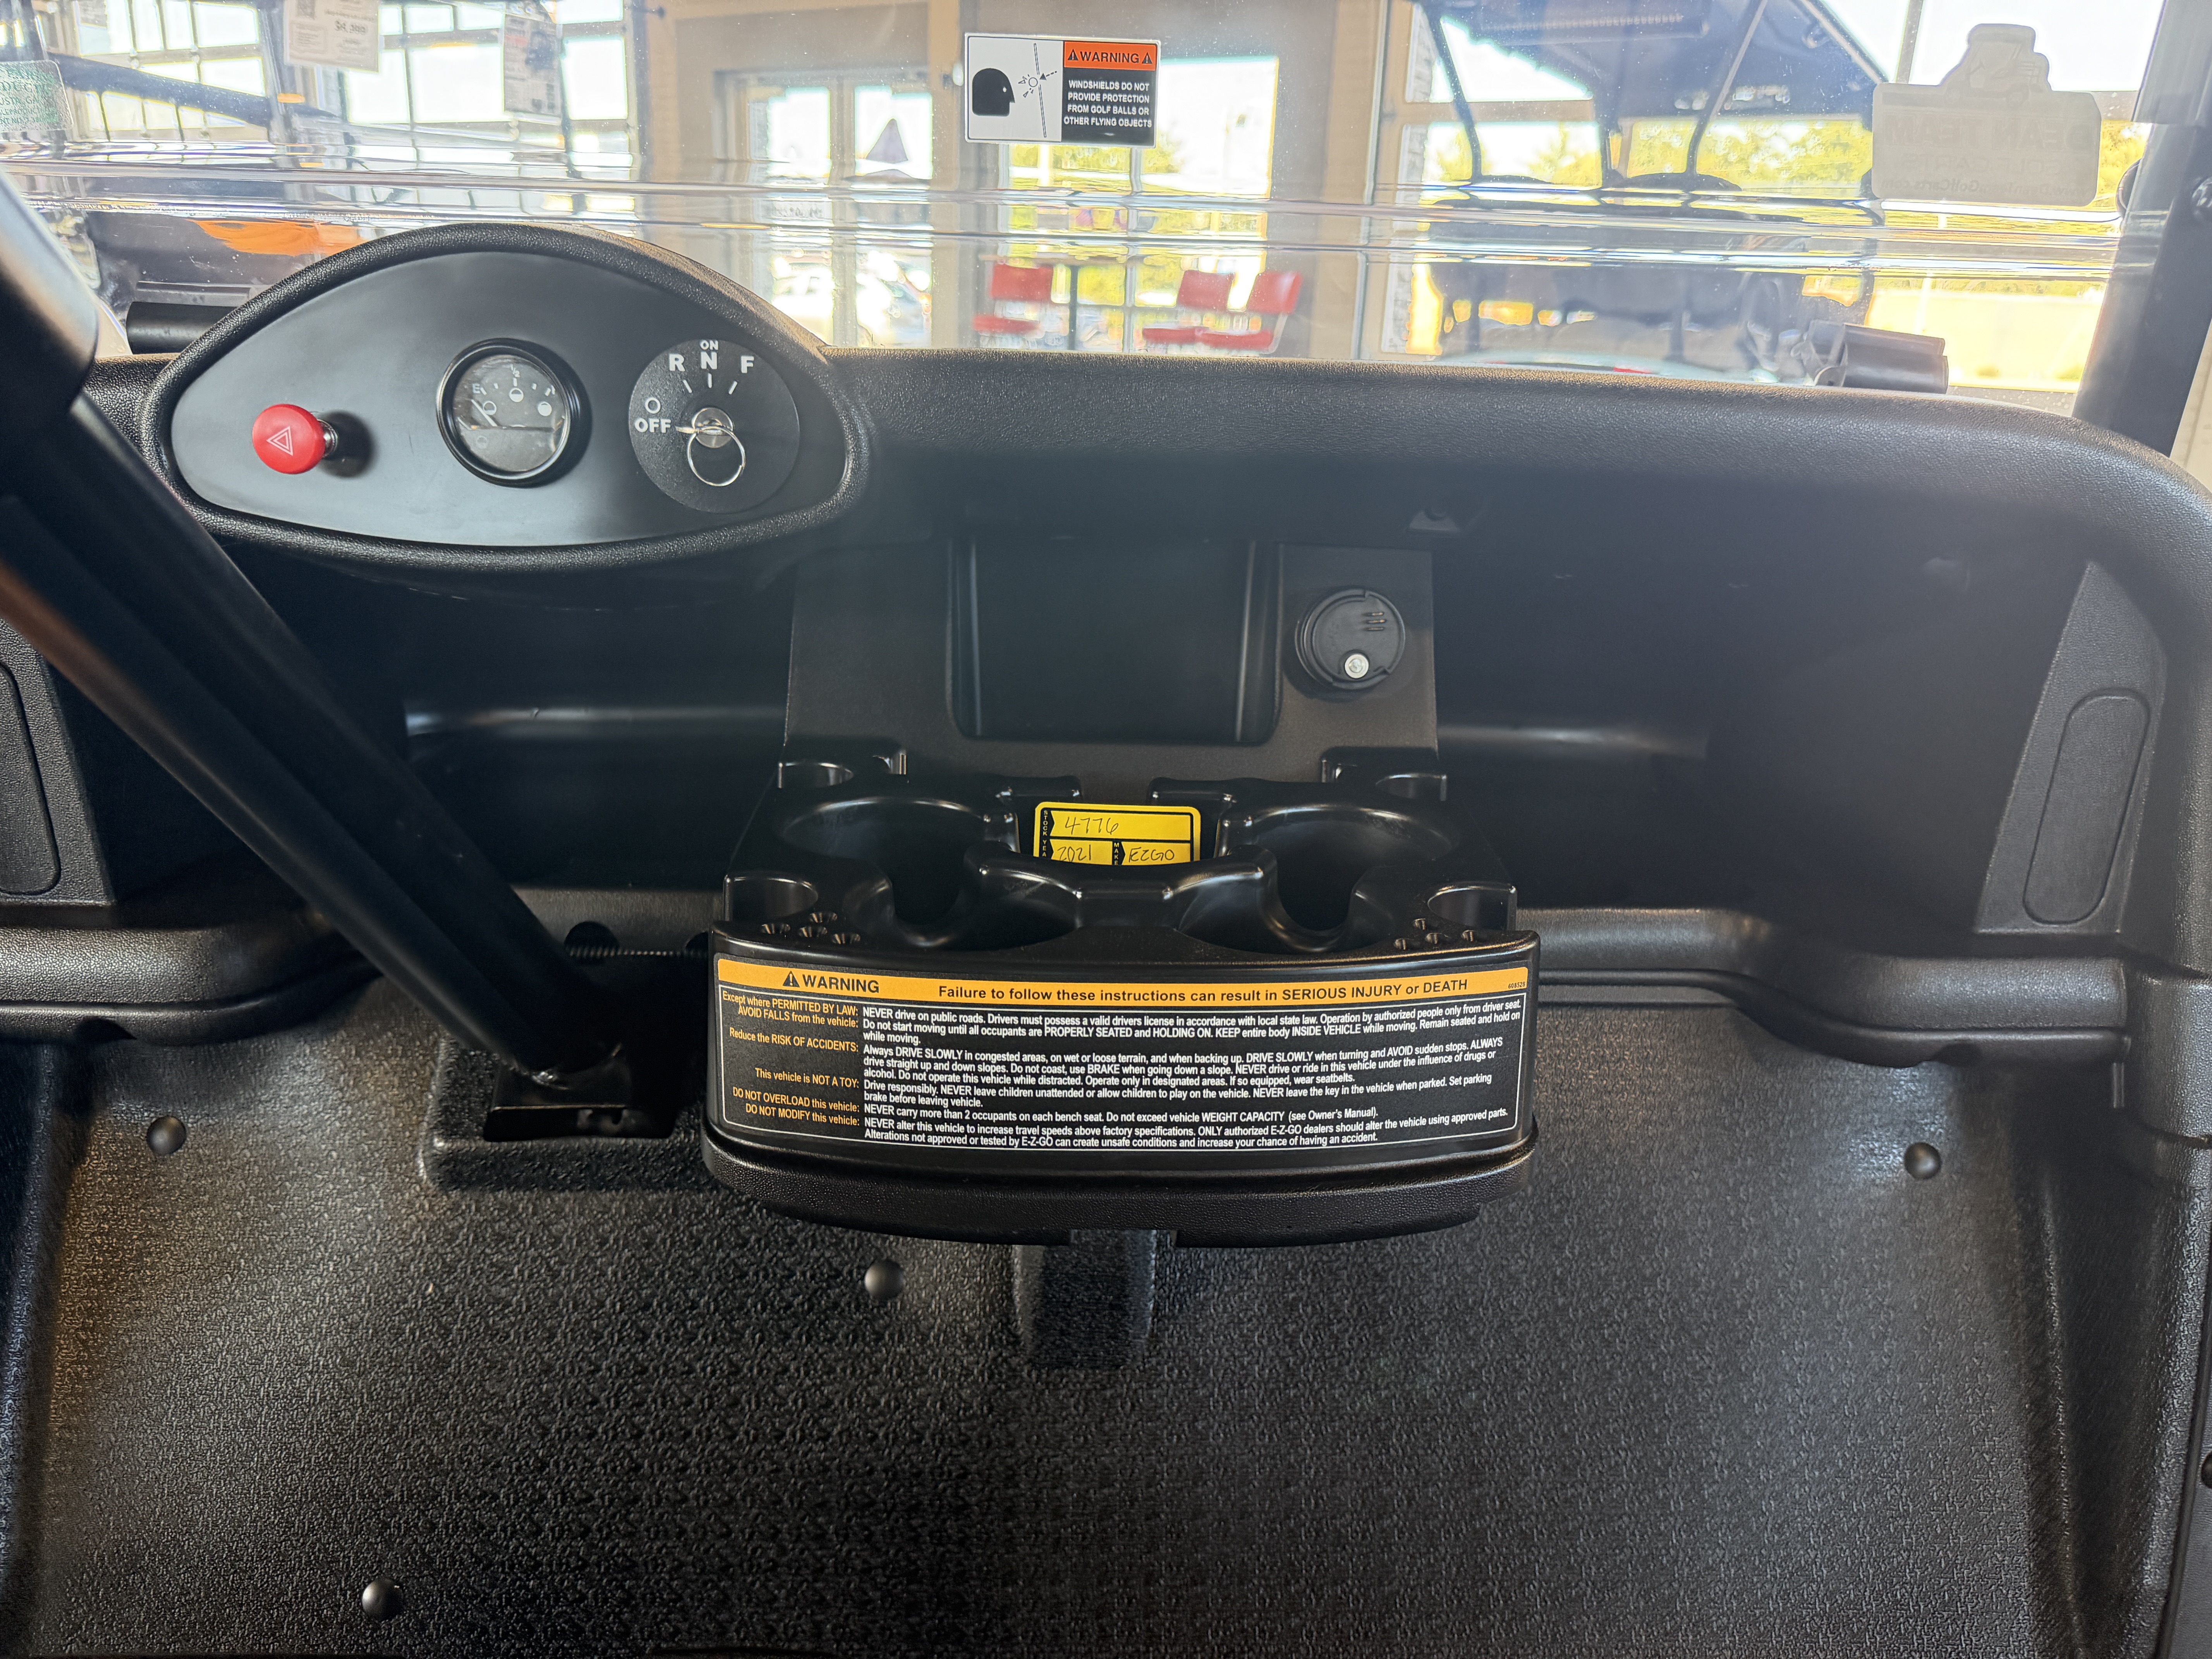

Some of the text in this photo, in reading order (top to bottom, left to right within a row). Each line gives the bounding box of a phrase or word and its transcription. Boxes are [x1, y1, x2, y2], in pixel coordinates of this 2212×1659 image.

[1080, 51, 1139, 64] WARNING
[1068, 80, 1149, 91] WINDSHIELDS DO NOT
[1068, 92, 1149, 103] PROVIDE PROTECTION
[1067, 104, 1149, 116] FROM GOLF BALLS OR
[1064, 117, 1152, 128] OTHER FLYING OBJECTS
[700, 340, 718, 350] ON
[669, 352, 754, 373] R N F
[472, 383, 481, 394] E
[635, 418, 671, 433] OFF
[1065, 816, 1119, 835] 4776
[1057, 844, 1092, 862] 2021
[802, 974, 879, 993] WARNING
[939, 979, 1468, 1001] Failure to follow these instructions can result in SERIOUS INJURY or DEATH
[1508, 981, 1526, 989] 608528
[723, 991, 858, 1016] Except where PERMITTED BY LAW:
[863, 1008, 893, 1019] NEVER
[895, 1009, 916, 1020] drive
[931, 1011, 957, 1024] public
[959, 1012, 986, 1023] roads.
[988, 1013, 1018, 1024] Drivers
[1020, 1015, 1042, 1024] must
[1044, 1017, 1080, 1027] possess
[1090, 1016, 1110, 1025] valid
[1112, 1016, 1142, 1026] drivers
[1144, 1016, 1175, 1026] license
[1176, 1016, 1184, 1026] in
[1186, 1016, 1236, 1026] accordance
[1238, 1016, 1256, 1025] with
[1258, 1015, 1278, 1025] local
[1279, 1015, 1300, 1025] state
[1302, 1014, 1318, 1024] law.
[1320, 1012, 1360, 1025] Operation
[1362, 1012, 1373, 1024] by
[1374, 1009, 1416, 1021] authorized
[1417, 1006, 1443, 1020] people
[1444, 1005, 1462, 1018] only
[1463, 1003, 1481, 1014] from
[1482, 1000, 1504, 1012] driver
[1504, 999, 1521, 1010] seat.
[738, 1005, 858, 1027] AVOID FALLS from the vehicle:
[730, 1027, 858, 1052] Reduce the RISK OF ACCIDENTS:
[863, 1030, 921, 1046] while moving.
[863, 1044, 894, 1058] Always
[896, 1047, 923, 1058] DRIVE
[925, 1048, 963, 1060] SLOWLY
[965, 1050, 973, 1060] in
[975, 1051, 1020, 1063] congested
[1022, 1054, 1048, 1064] areas,
[1063, 1054, 1080, 1062] wet
[1092, 1053, 1116, 1063] loose
[1118, 1053, 1148, 1065] terrain,
[1150, 1053, 1167, 1063] and
[1169, 1053, 1192, 1063] when
[1194, 1053, 1228, 1065] backing
[1231, 1055, 1244, 1065] up.
[1246, 1052, 1274, 1062] DRIVE
[1276, 1051, 1314, 1061] SLOWLY
[1314, 1050, 1337, 1060] when
[1339, 1048, 1369, 1061] turning
[1370, 1048, 1386, 1058] and
[1387, 1046, 1413, 1057] AVOID
[1415, 1043, 1444, 1055] sudden
[1445, 1041, 1469, 1054] stops.
[1470, 1036, 1503, 1049] ALWAYS
[755, 1067, 859, 1088] This vehicle is NOT A TOY:
[733, 1087, 859, 1112] DO NOT OVERLOAD this vehicle:
[864, 1091, 983, 1108] brake before leaving vehicle.
[746, 1103, 859, 1126] DO NOT MODIFY this vehicle:
[864, 1103, 895, 1115] NEVER
[896, 1108, 918, 1119] carry
[920, 1110, 942, 1118] more
[944, 1109, 963, 1119] than
[965, 1109, 970, 1119] 2
[972, 1111, 1017, 1122] occupants
[1032, 1111, 1053, 1121] each
[1055, 1111, 1082, 1121] bench
[1084, 1113, 1104, 1121] seat.
[1106, 1112, 1119, 1121] Do
[1121, 1113, 1135, 1121] not
[1137, 1112, 1168, 1121] exceed
[1169, 1112, 1200, 1122] vehicle
[1201, 1112, 1238, 1121] WEIGHT
[1240, 1111, 1285, 1121] CAPACITY
[1288, 1110, 1307, 1122] (see
[1344, 1106, 1378, 1120] Manual).
